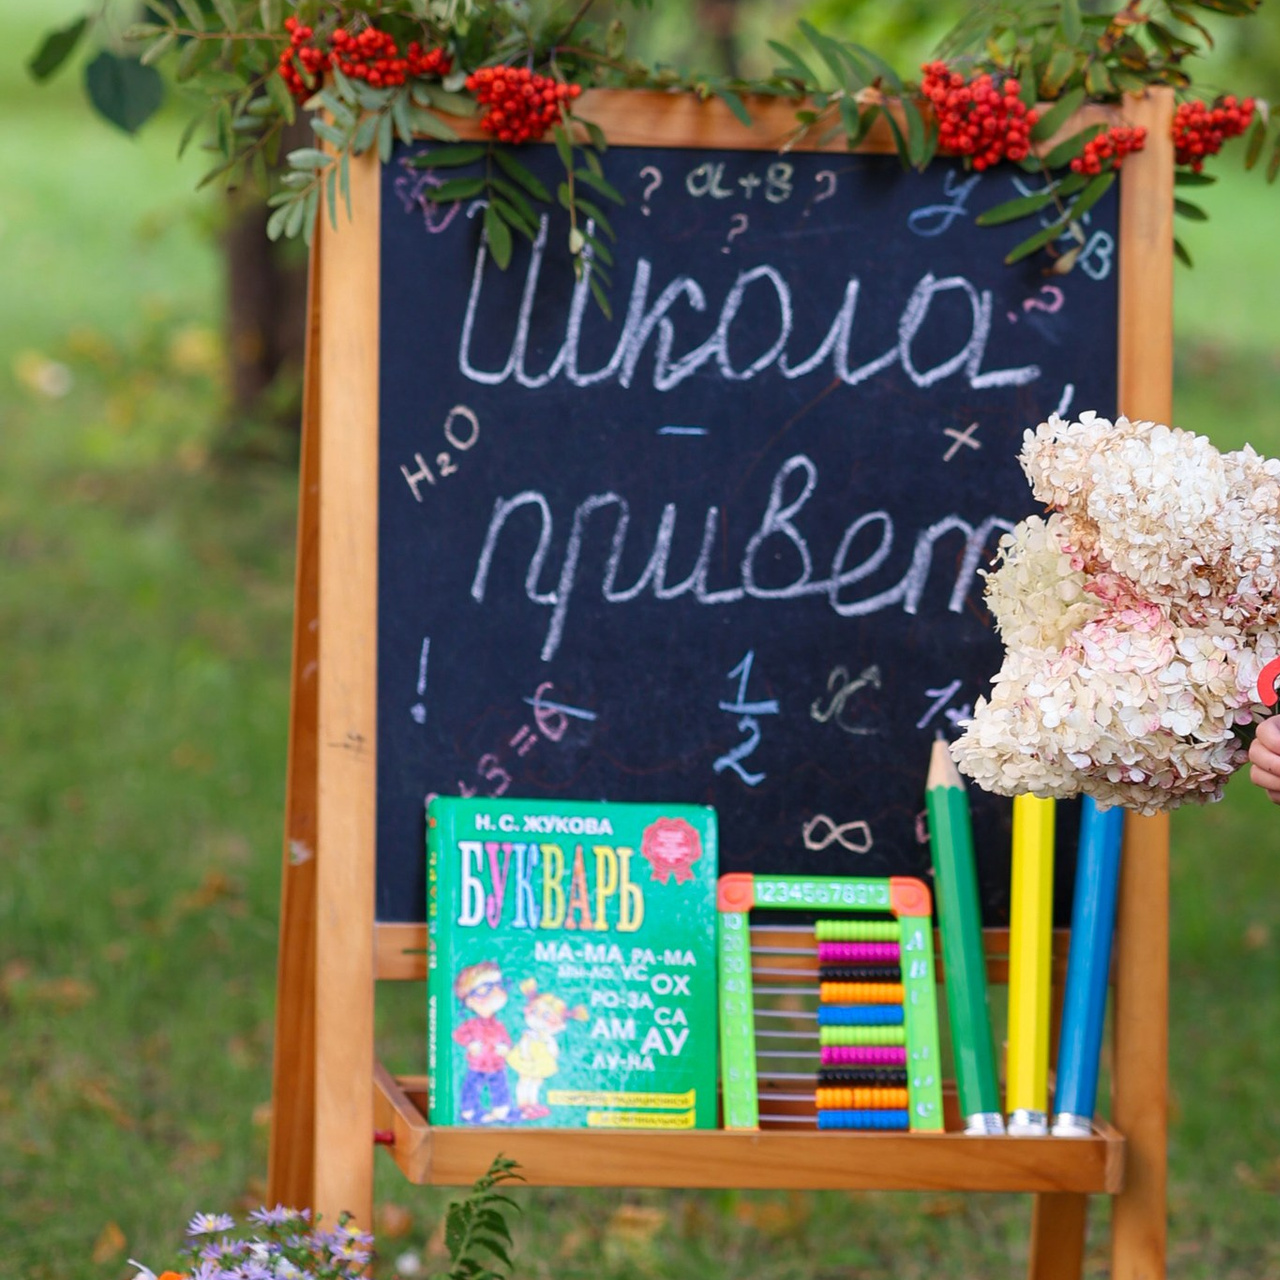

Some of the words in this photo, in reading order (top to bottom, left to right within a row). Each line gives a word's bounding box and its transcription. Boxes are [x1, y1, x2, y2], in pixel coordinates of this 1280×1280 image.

[475, 814, 497, 831] Н.
[499, 814, 520, 833] С.
[523, 815, 614, 836] ЖУКОВА
[457, 840, 645, 932] БУКВАРЬ
[535, 942, 624, 964] МА-МА
[631, 947, 697, 967] РА-МА
[620, 963, 649, 982] УС
[651, 973, 692, 996] ОХ
[591, 990, 655, 1010] РО-ЗА
[654, 1006, 688, 1026] СА
[591, 1018, 636, 1040] АМ
[640, 1026, 690, 1056] АУ
[591, 1053, 655, 1071] ЛУ-НА
